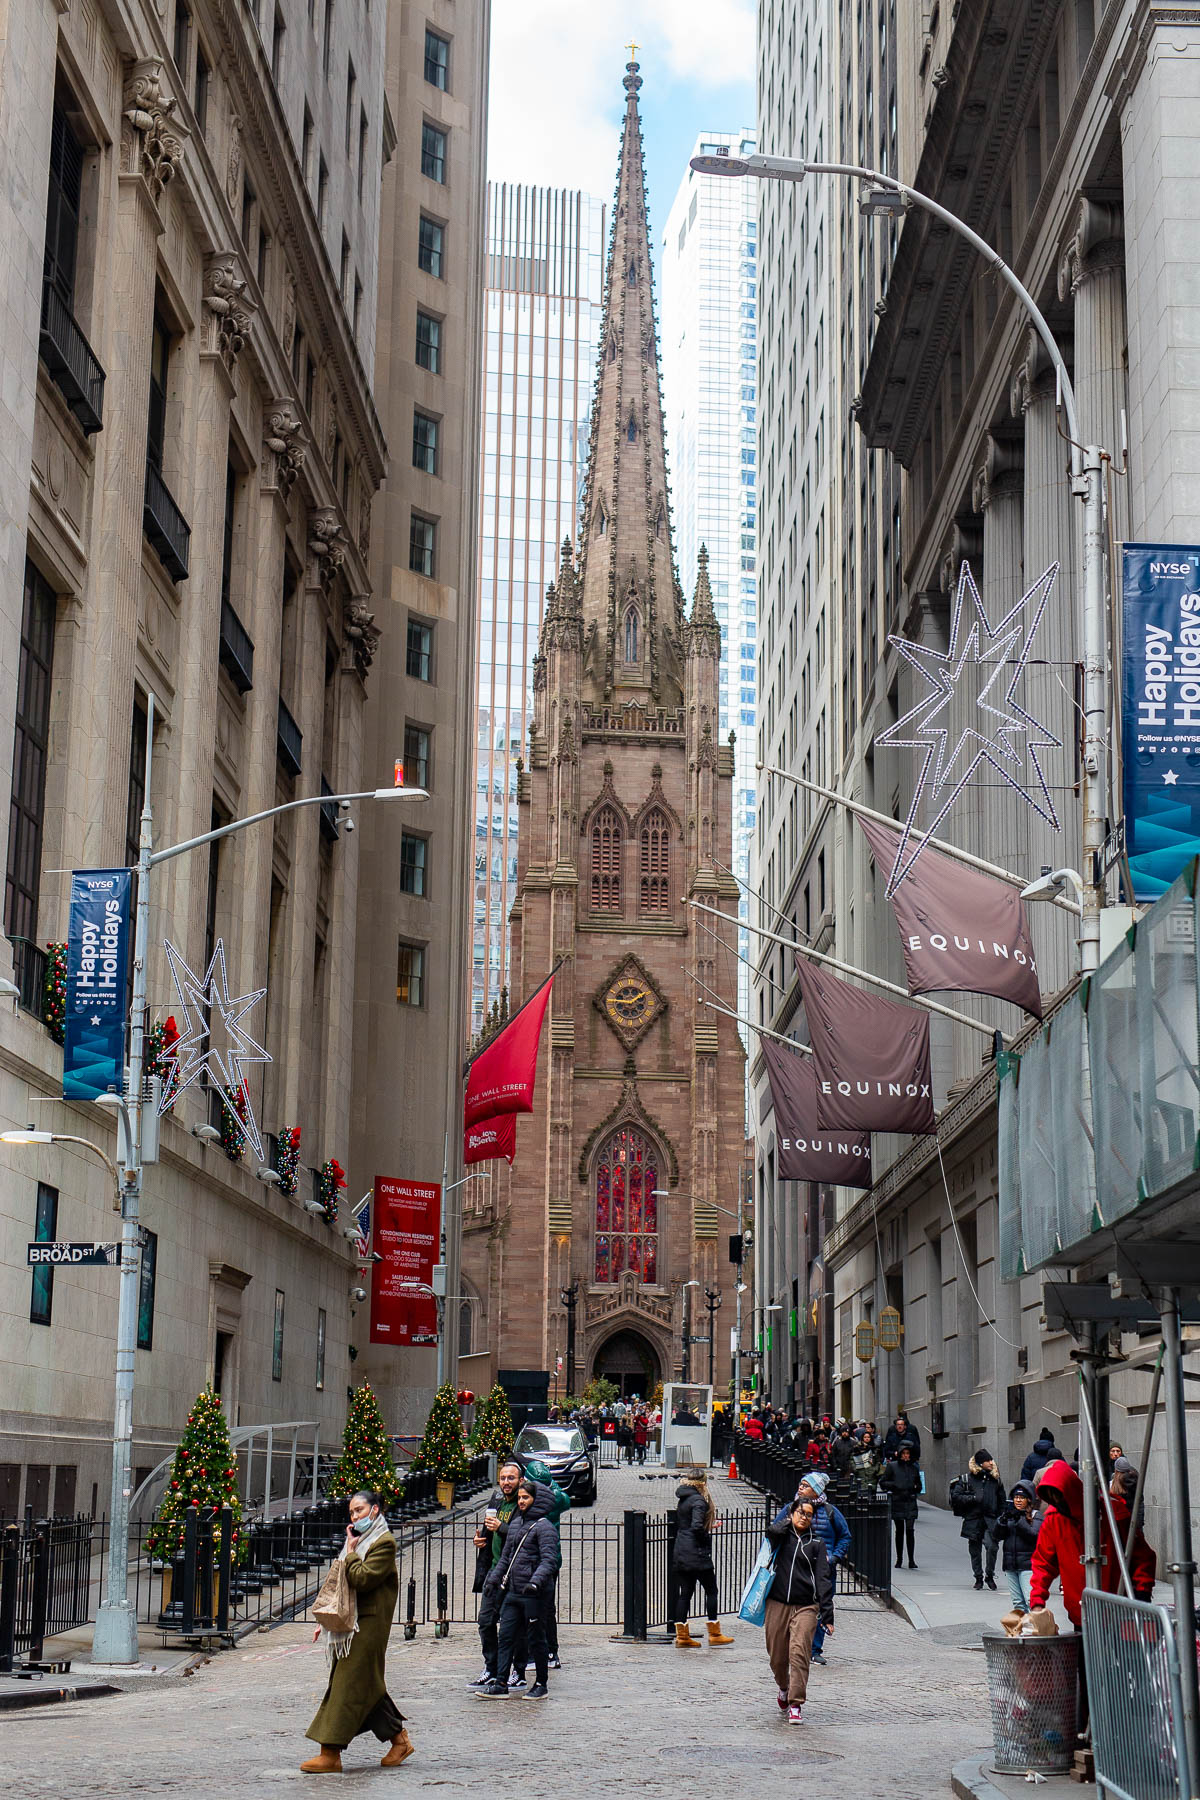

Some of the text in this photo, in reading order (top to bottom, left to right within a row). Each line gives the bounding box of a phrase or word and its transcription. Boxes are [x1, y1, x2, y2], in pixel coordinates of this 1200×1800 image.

[1138, 624, 1172, 726] Happy
[1174, 593, 1200, 726] Holidays
[76, 920, 100, 987] Happy
[98, 900, 122, 988] Holidays
[908, 934, 1038, 976] EQUINOX
[468, 1083, 527, 1104] ONE WALL STREET
[822, 1081, 930, 1098] EQUINOX
[782, 1138, 870, 1160] EQUINOX
[381, 1184, 435, 1198] ONE WALL STREET
[29, 1249, 82, 1262] BROAD
